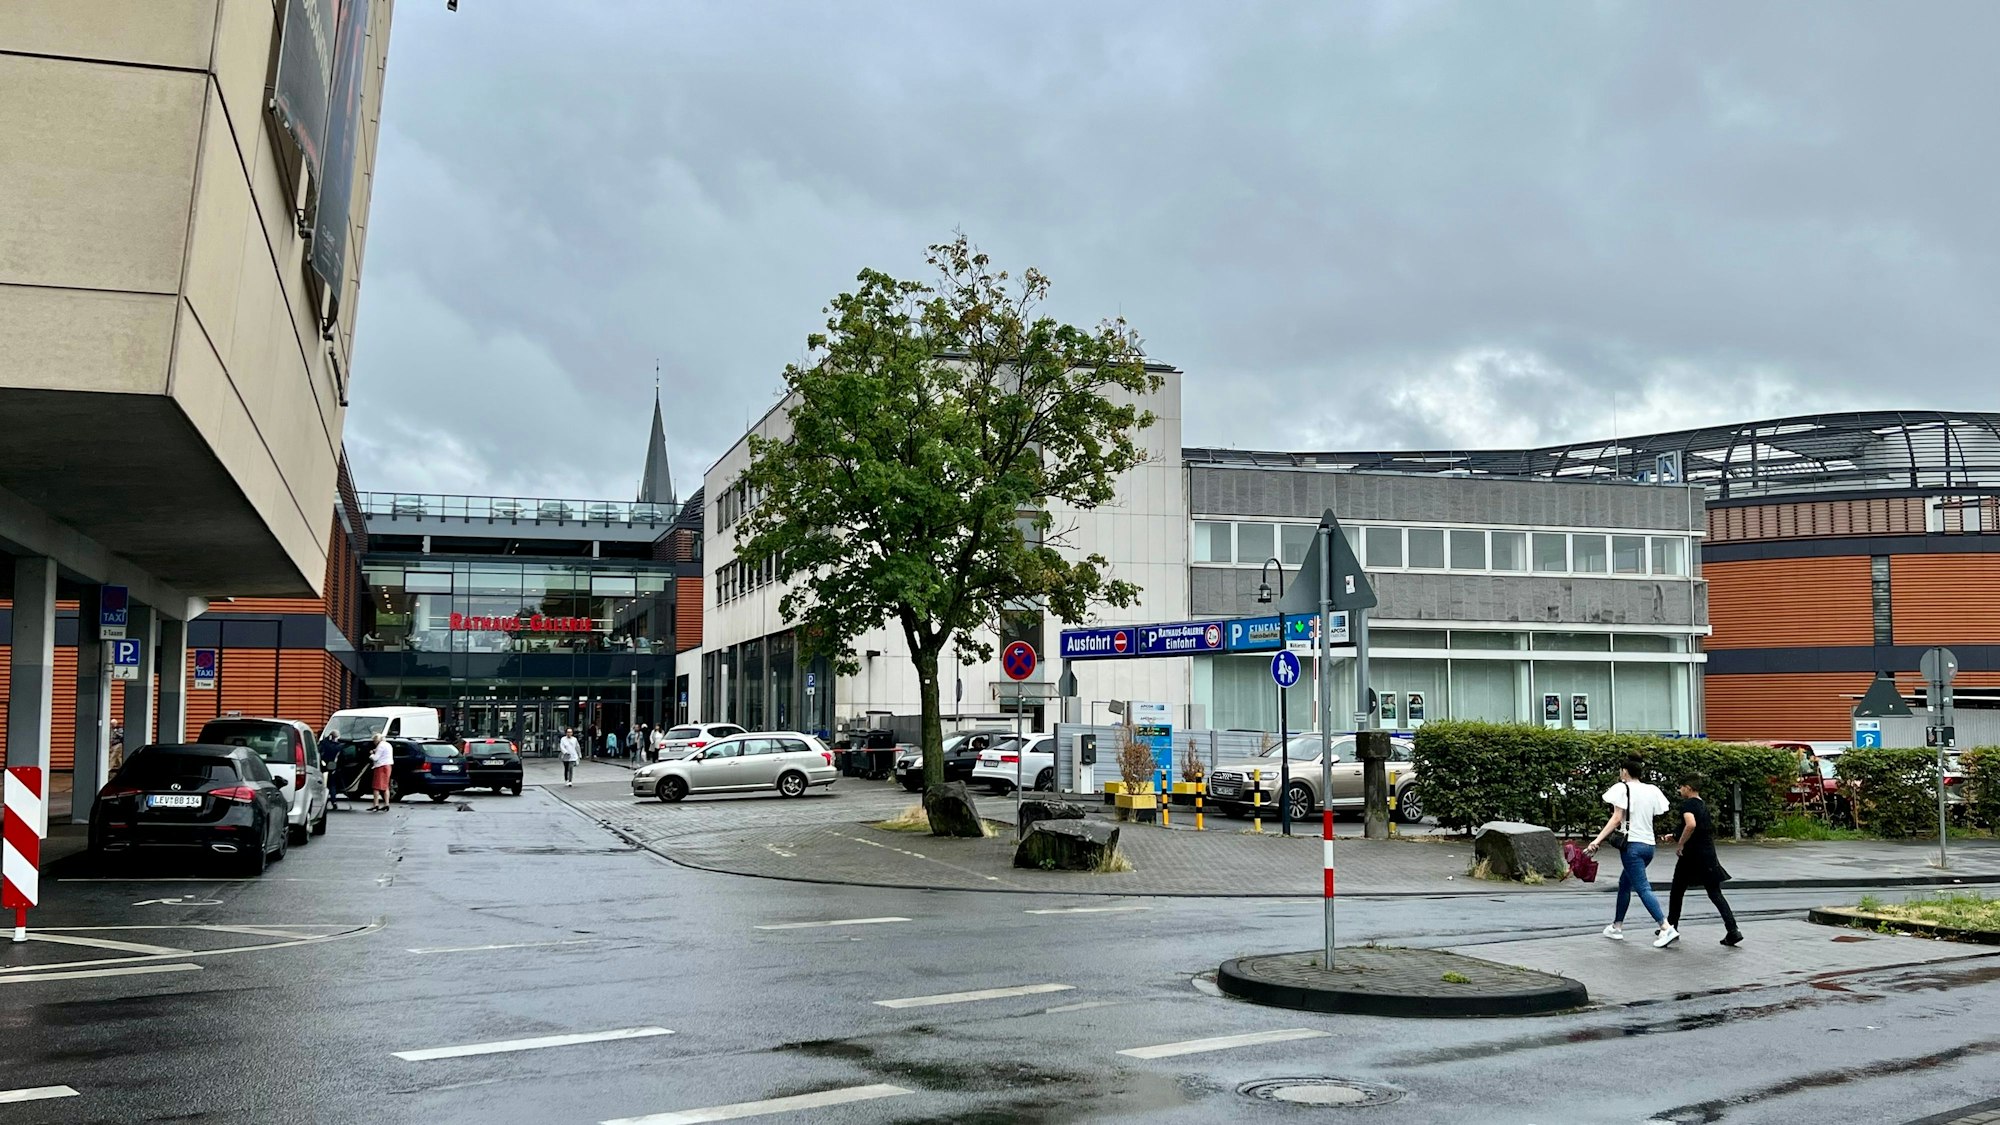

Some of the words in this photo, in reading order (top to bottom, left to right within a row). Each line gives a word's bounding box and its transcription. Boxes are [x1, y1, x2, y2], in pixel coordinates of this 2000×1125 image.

[103, 612, 125, 623] TAXI
[449, 611, 521, 632] RATHAUS
[529, 613, 592, 632] GALERIE
[1158, 626, 1204, 638] RATHAUS-GALERIE
[1232, 623, 1243, 645] P
[1067, 635, 1110, 652] Ausfahrt
[1149, 631, 1158, 647] P
[1165, 637, 1196, 650] Einfahrt
[119, 642, 134, 663] P
[197, 669, 213, 677] TAXI
[808, 675, 815, 686] P
[1866, 736, 1874, 747] P
[154, 796, 170, 805] LEV
[186, 796, 200, 805] 134
